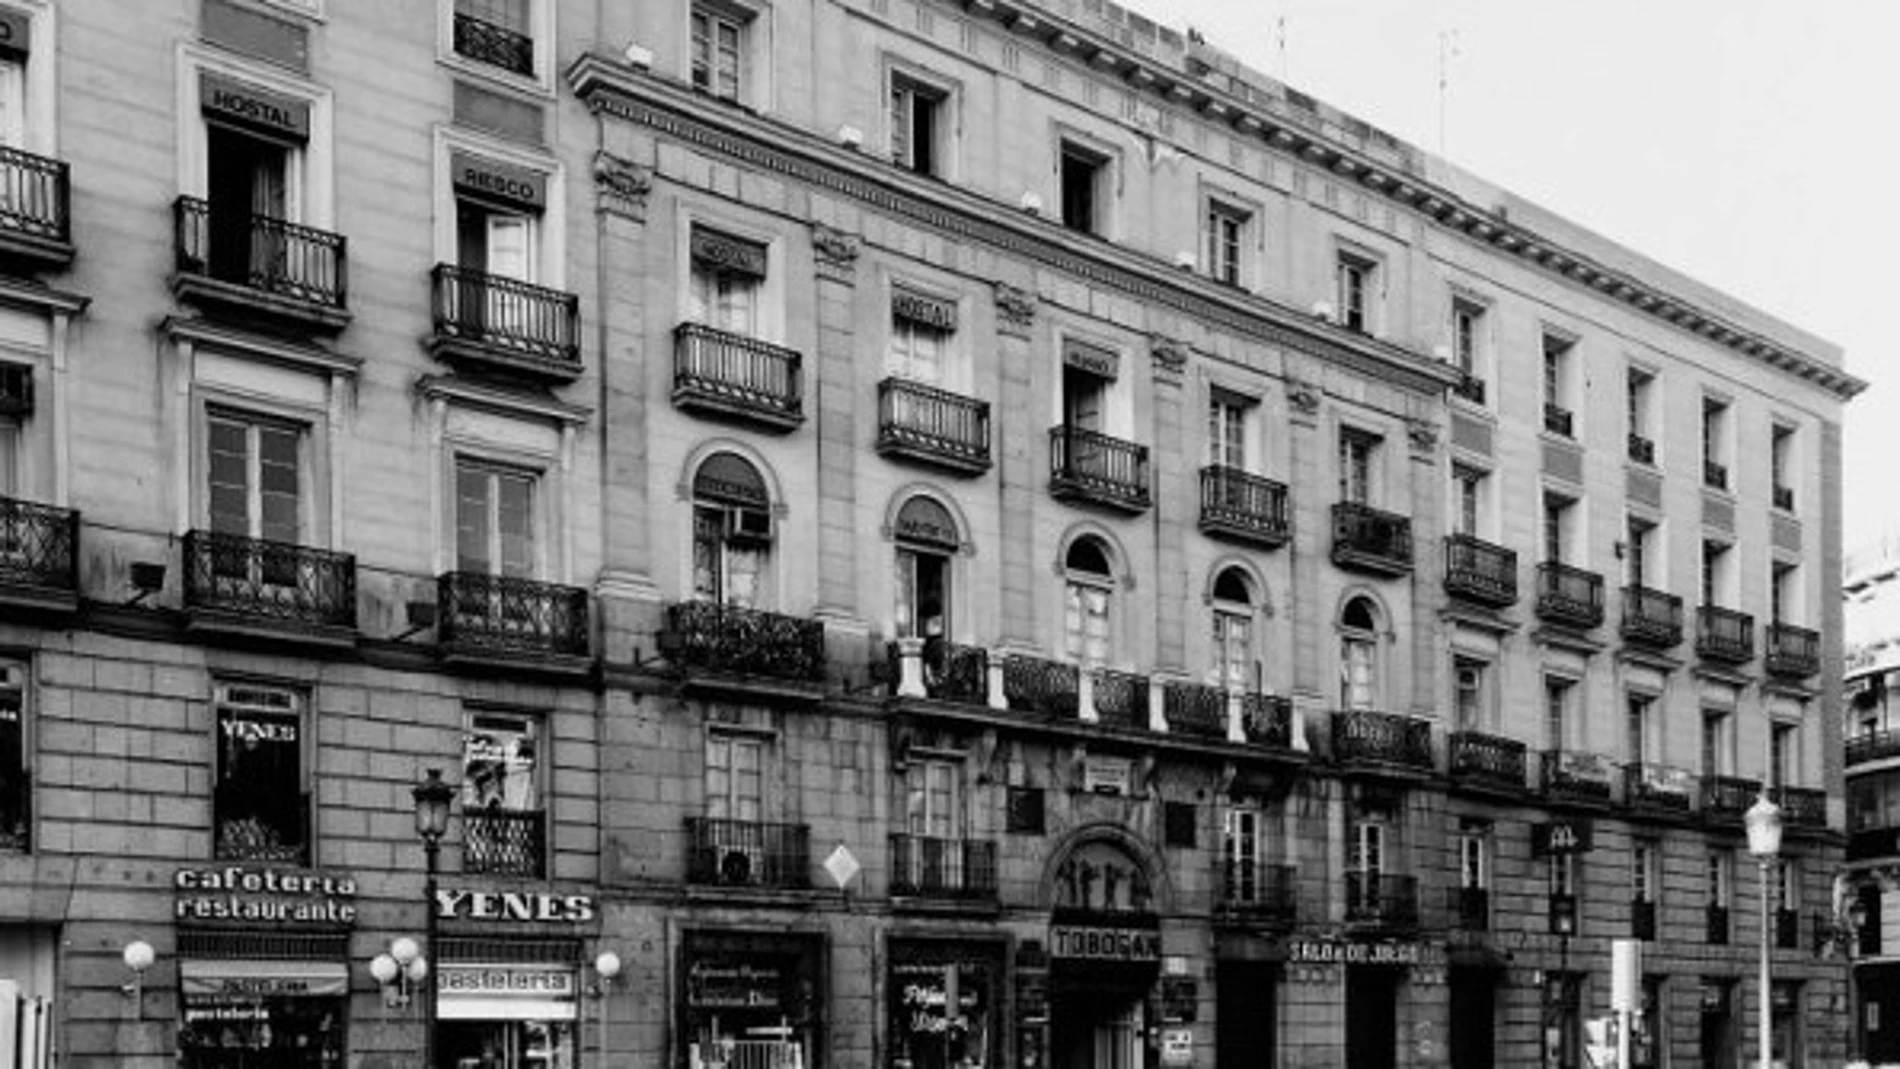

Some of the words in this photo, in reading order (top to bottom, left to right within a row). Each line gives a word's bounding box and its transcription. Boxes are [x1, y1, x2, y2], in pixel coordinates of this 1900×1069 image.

[213, 88, 298, 128] HOSTAL
[465, 168, 534, 199] RIESCO
[221, 718, 296, 742] YENES
[176, 867, 356, 896] cafeteria
[177, 896, 356, 922] restaurante
[436, 889, 593, 921] YENES
